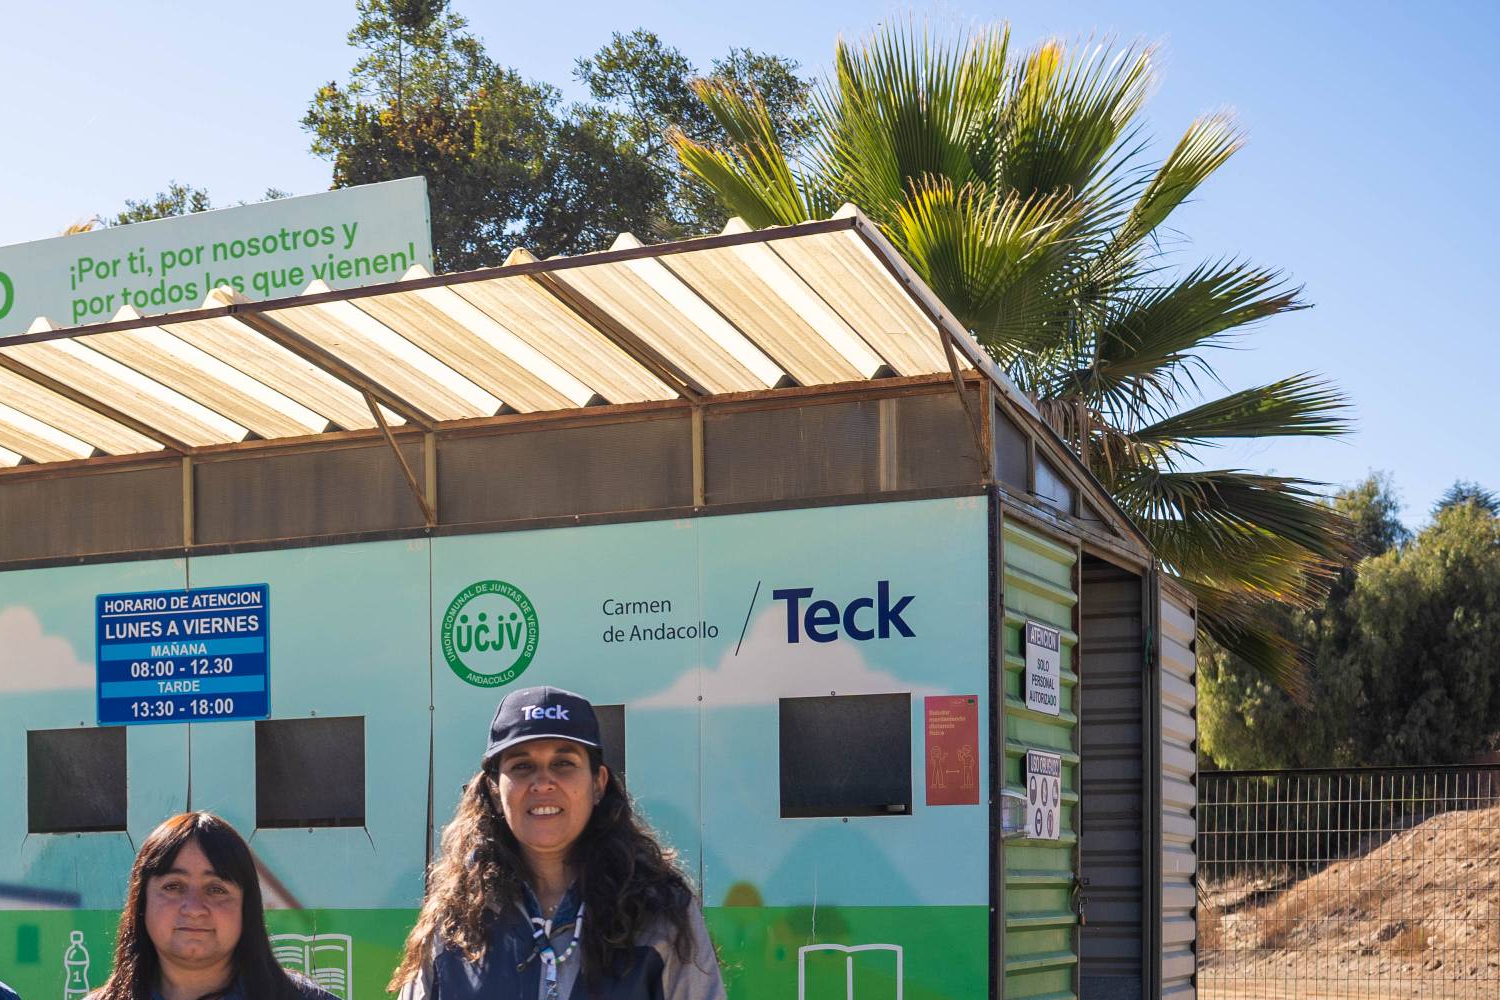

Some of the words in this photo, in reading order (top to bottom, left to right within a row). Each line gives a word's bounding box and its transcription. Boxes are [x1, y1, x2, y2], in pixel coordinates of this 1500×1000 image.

[70, 257, 121, 291] ¡Por
[127, 247, 153, 278] ti,
[160, 246, 205, 277] por
[212, 222, 335, 262] nosotros
[342, 221, 359, 250] y
[72, 294, 115, 324] por
[121, 277, 198, 309] todos
[252, 265, 305, 297] que
[311, 241, 416, 282] vienen!
[475, 583, 488, 594] DE
[489, 583, 522, 602] JUNTAS
[104, 597, 167, 613] HORARIO
[170, 596, 189, 609] DE
[192, 591, 261, 608] ATENCION
[445, 590, 475, 630] COMUNAL
[520, 600, 531, 614] DE
[602, 599, 671, 616] Carmen
[773, 580, 916, 644] Teck
[105, 621, 162, 640] LUNES
[166, 620, 179, 636] A
[183, 615, 260, 635] VIERNES
[523, 614, 537, 658] VECINOS
[603, 625, 625, 643] de
[629, 621, 719, 642] Andacollo
[150, 642, 207, 657] MAÑANA
[444, 631, 456, 662] UNION
[131, 661, 174, 677] 08:00
[190, 657, 233, 675] 12.30
[1037, 658, 1049, 672] SOLO
[158, 680, 200, 693] TARDE
[466, 670, 515, 685] ANDACOLLO
[1031, 673, 1055, 690] PERSONAL
[131, 701, 174, 717] 13:30
[190, 698, 234, 715] 18:00
[1029, 690, 1056, 706] AUTORIZADO
[521, 704, 570, 721] Teck
